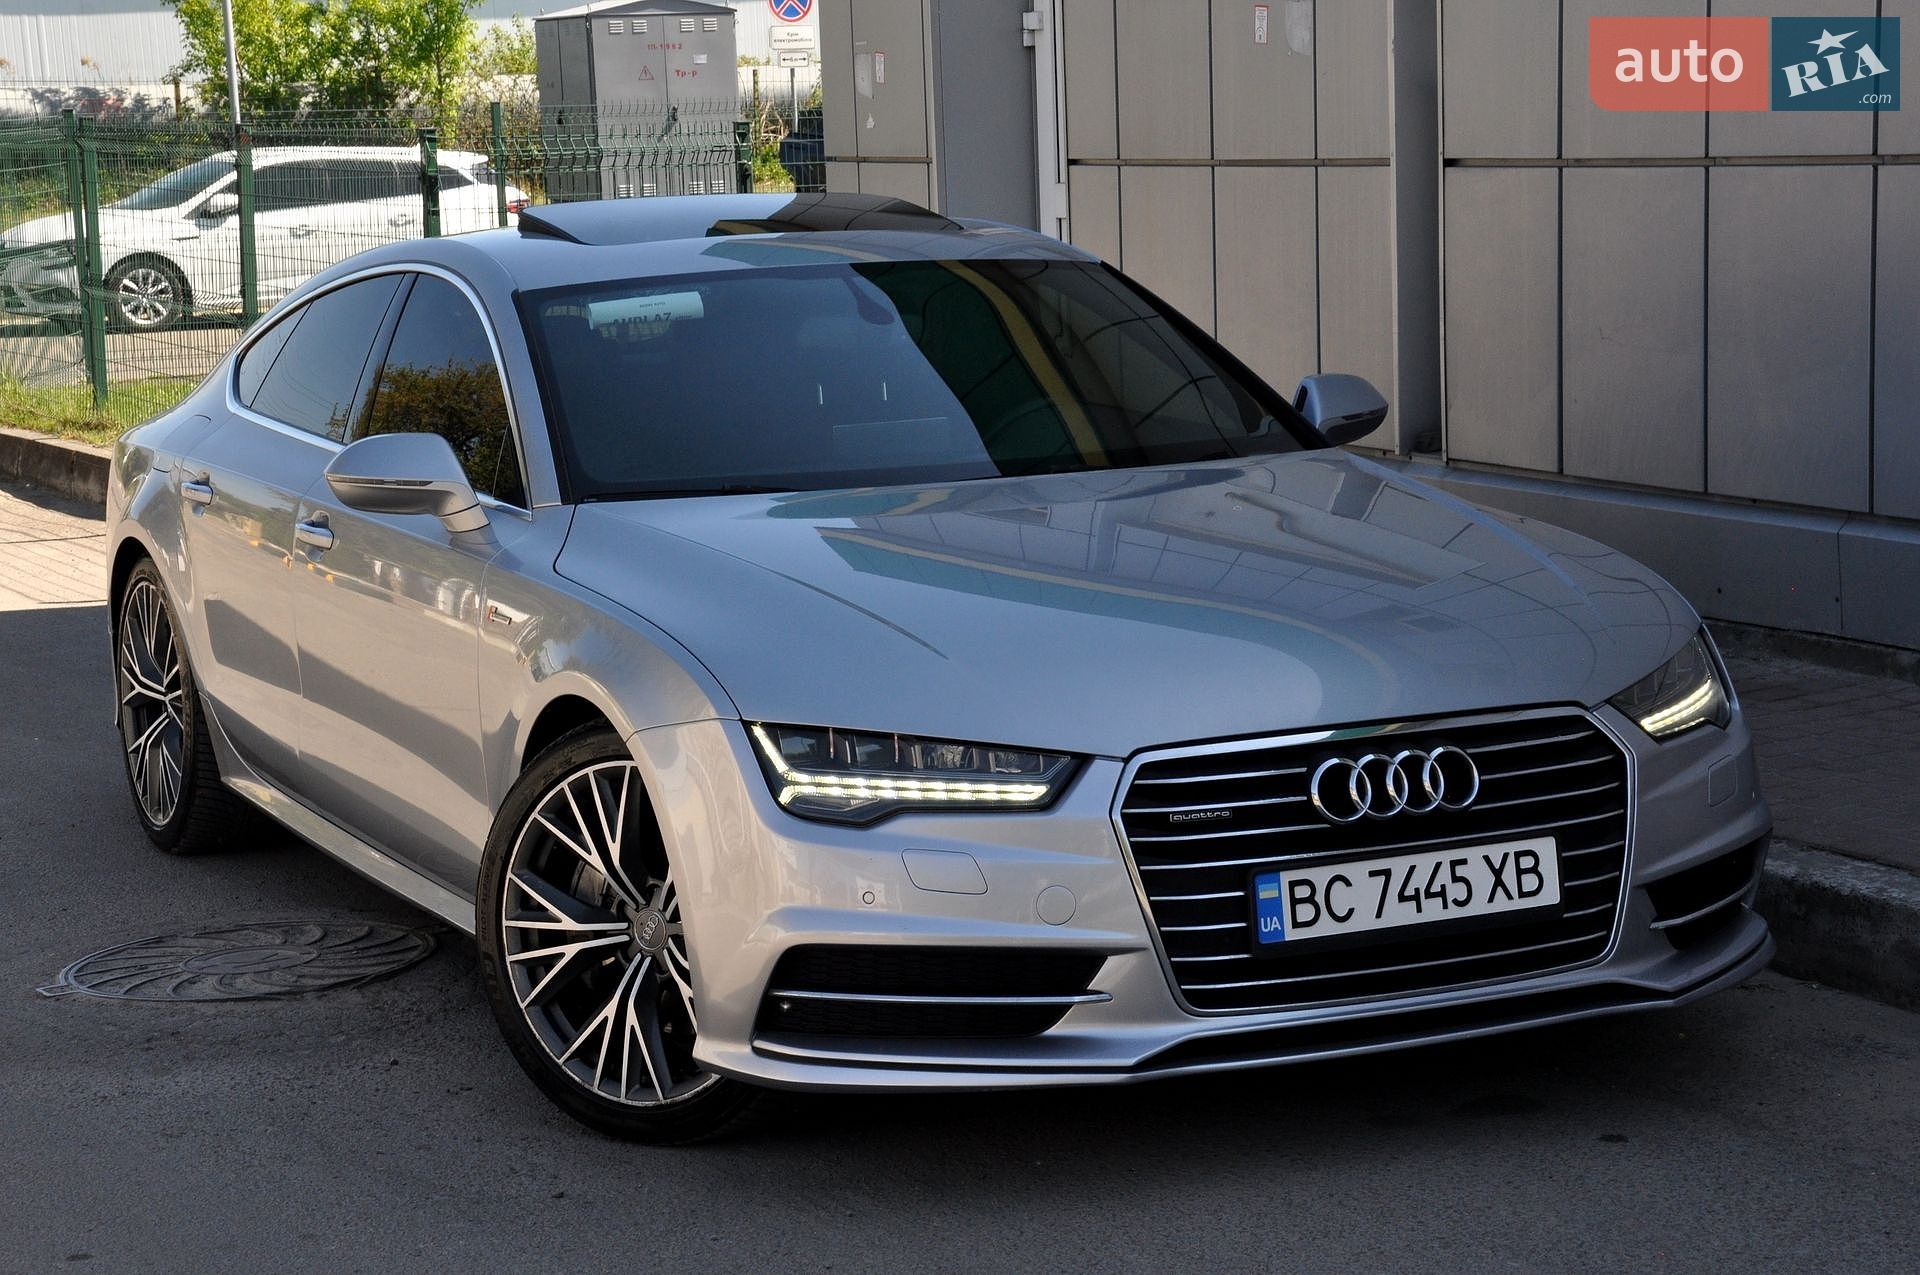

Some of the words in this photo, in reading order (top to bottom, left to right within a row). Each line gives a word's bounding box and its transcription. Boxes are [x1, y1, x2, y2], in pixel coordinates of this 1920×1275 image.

[1173, 810, 1230, 821] quattro
[1288, 873, 1355, 930] BC
[1368, 857, 1473, 919] 7445
[1482, 849, 1544, 905] XB
[1260, 916, 1282, 932] UA
